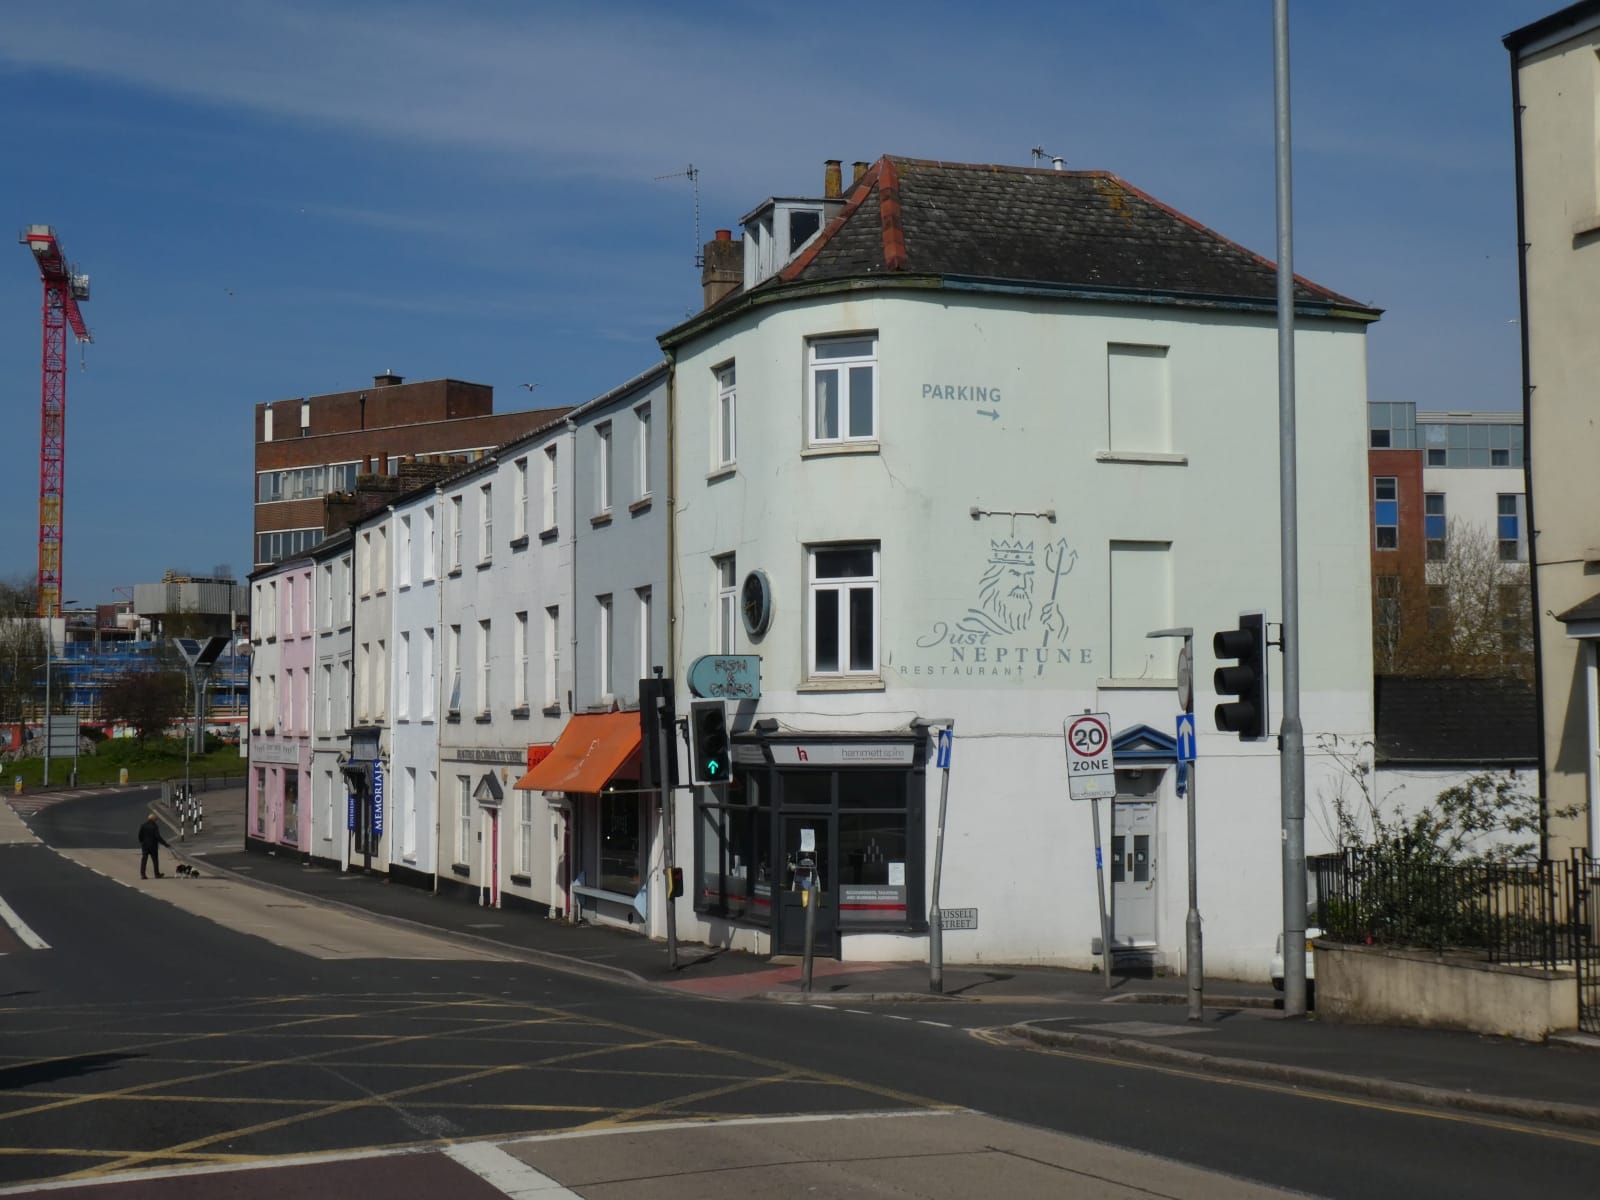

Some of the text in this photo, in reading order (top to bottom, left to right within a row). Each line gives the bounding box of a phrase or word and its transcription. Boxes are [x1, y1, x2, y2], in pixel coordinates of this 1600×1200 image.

[922, 384, 1001, 402] PARKING
[916, 622, 991, 648] Just
[951, 646, 1093, 664] NEPTUNE
[714, 659, 748, 673] FISH
[710, 683, 753, 697] CHIPS
[1074, 728, 1103, 746] 20
[1072, 759, 1109, 771] ZONE
[374, 761, 383, 830] MEMORIALS
[942, 910, 973, 919] USSELL
